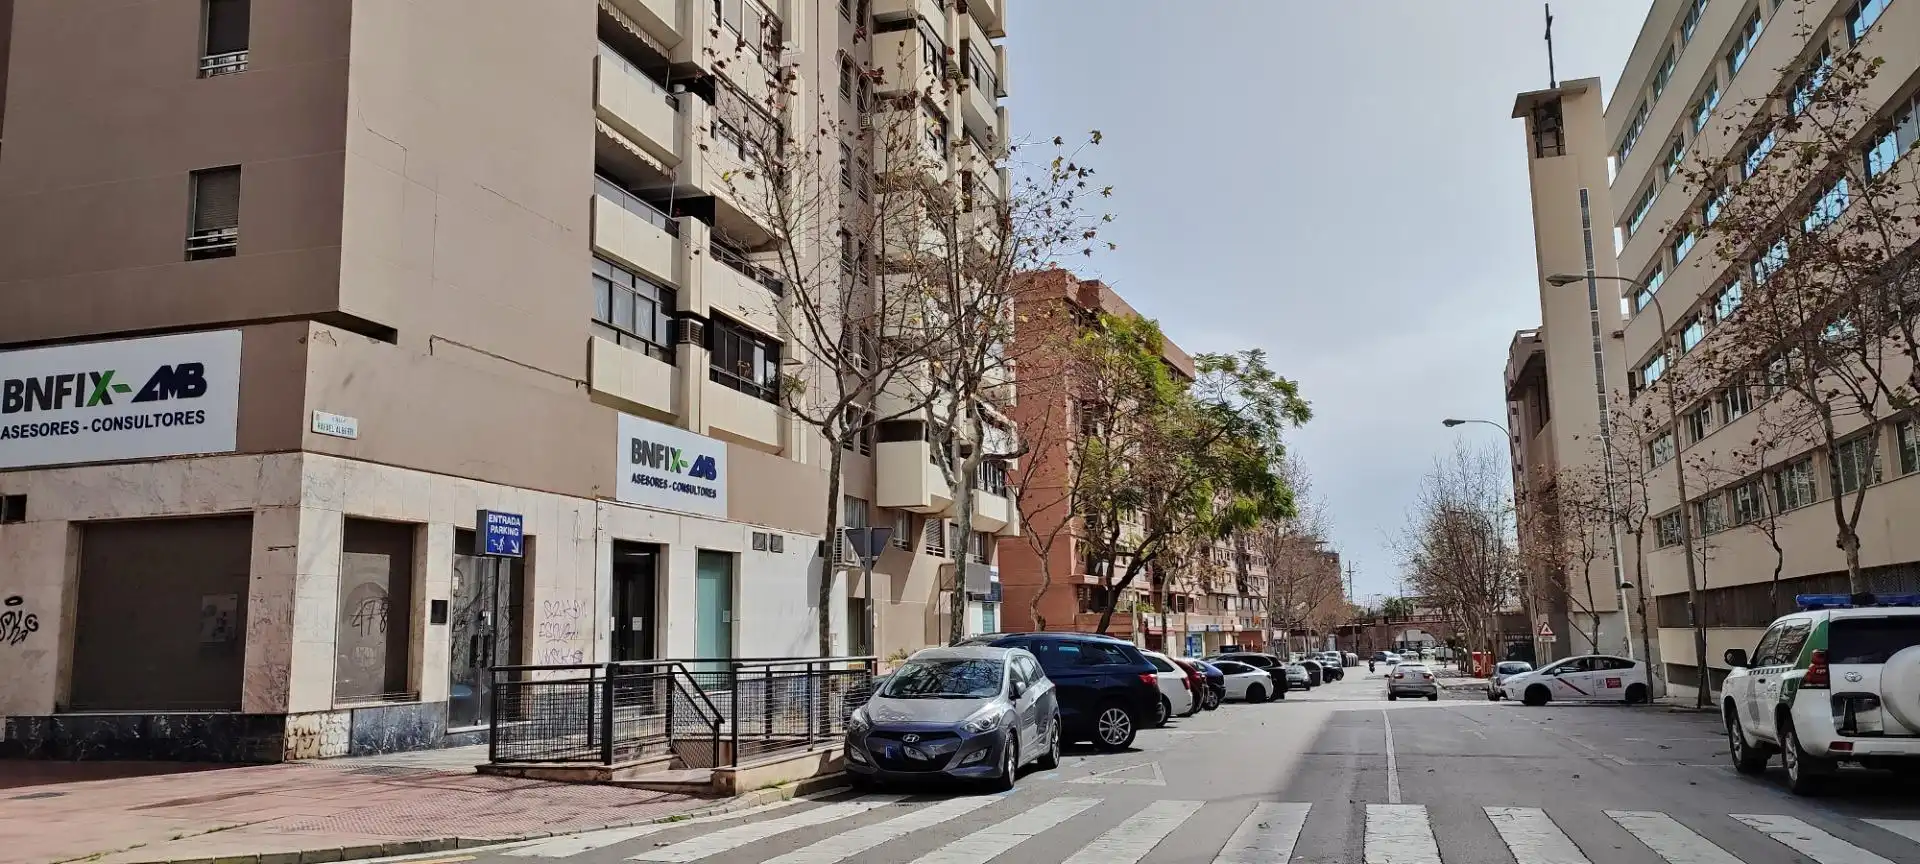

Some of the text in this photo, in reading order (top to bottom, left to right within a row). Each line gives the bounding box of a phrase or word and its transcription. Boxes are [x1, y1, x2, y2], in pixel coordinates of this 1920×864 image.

[0, 420, 80, 440] ASESORES
[91, 410, 206, 433] CONSULTORES
[631, 472, 668, 490] ASESORES
[672, 481, 717, 499] CONSULTORES
[488, 514, 521, 526] ENTRADA
[490, 524, 519, 536] PARKING
